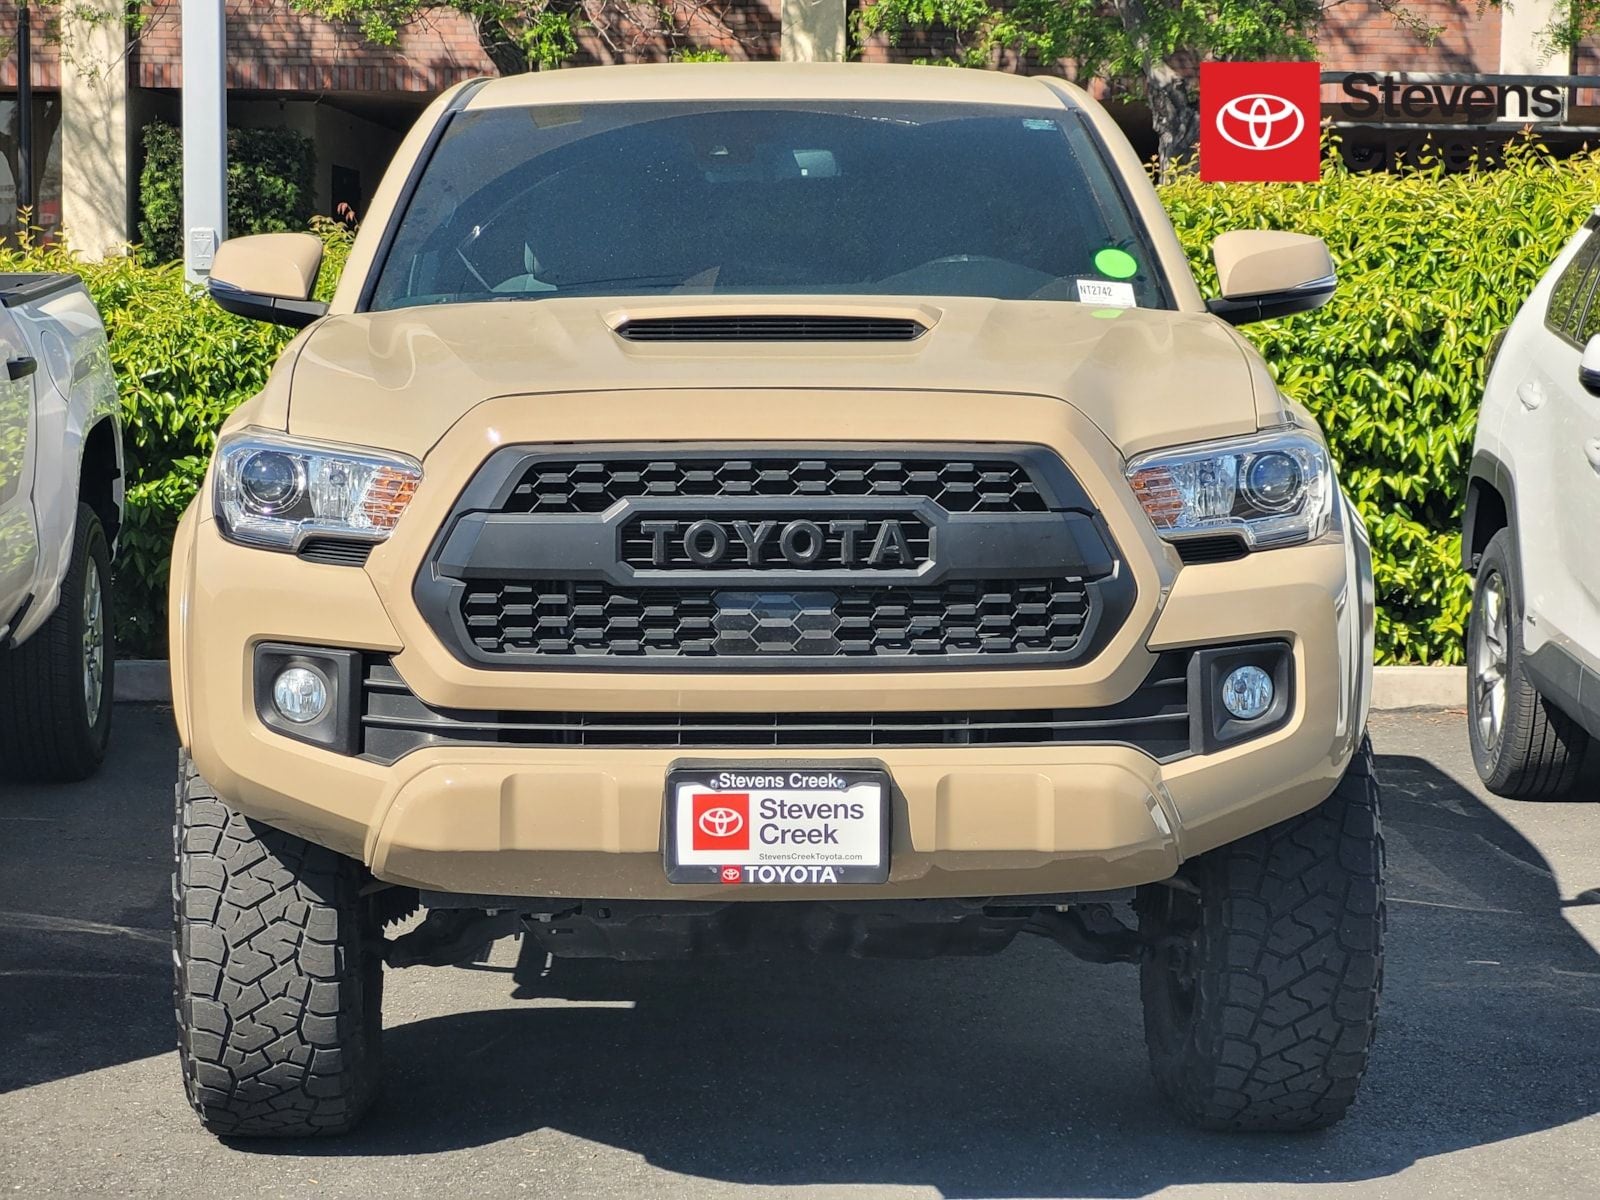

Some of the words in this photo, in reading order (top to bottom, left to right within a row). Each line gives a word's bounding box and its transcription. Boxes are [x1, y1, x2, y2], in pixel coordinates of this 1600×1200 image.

[1080, 285, 1113, 297] NT2742
[640, 519, 915, 566] TOYOTA
[719, 773, 785, 789] Stevens
[789, 773, 838, 789] Creek
[759, 798, 865, 820] Stevens
[759, 823, 839, 845] Creek
[759, 853, 863, 862] StevensCreekToyota.com
[744, 865, 838, 883] TOYOTA
